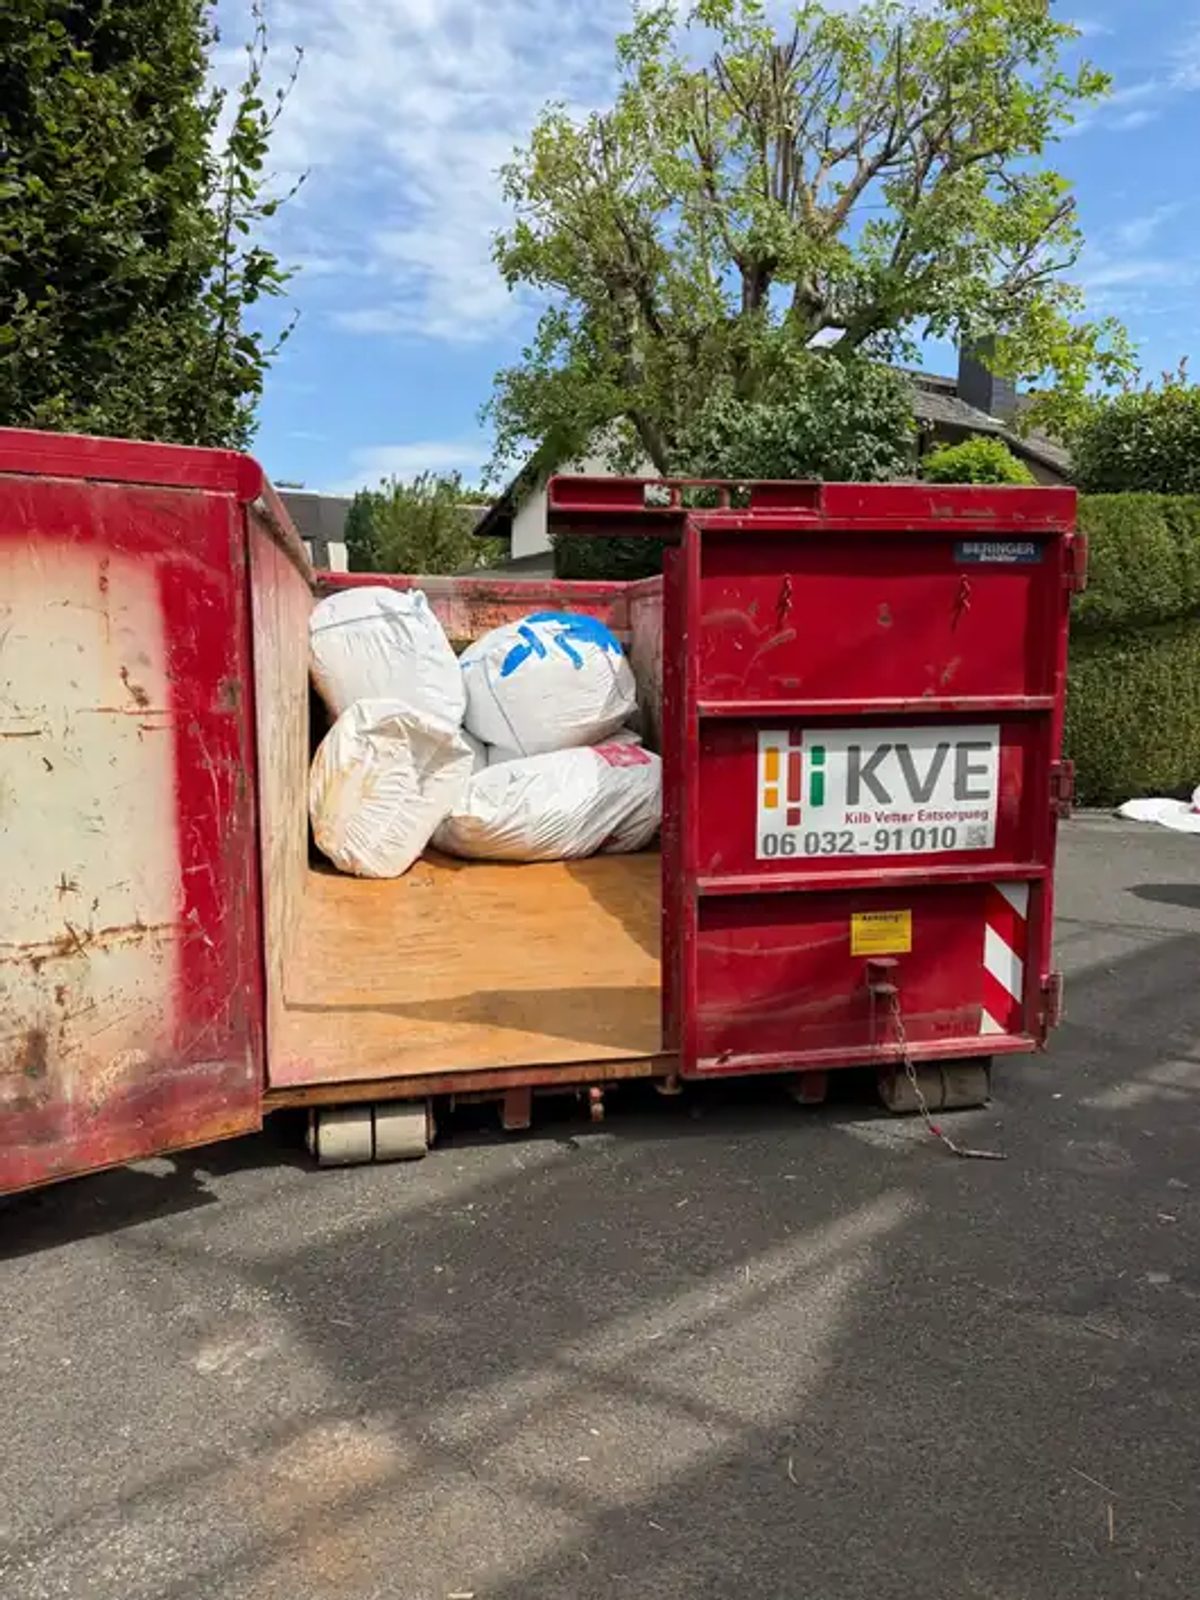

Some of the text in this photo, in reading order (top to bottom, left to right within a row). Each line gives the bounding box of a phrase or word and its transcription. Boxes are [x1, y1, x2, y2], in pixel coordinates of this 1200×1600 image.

[846, 742, 992, 805] KVE
[844, 812, 871, 824] Kilb
[917, 809, 989, 822] Entsorgung
[762, 833, 796, 856] 06
[910, 826, 957, 850] 010
